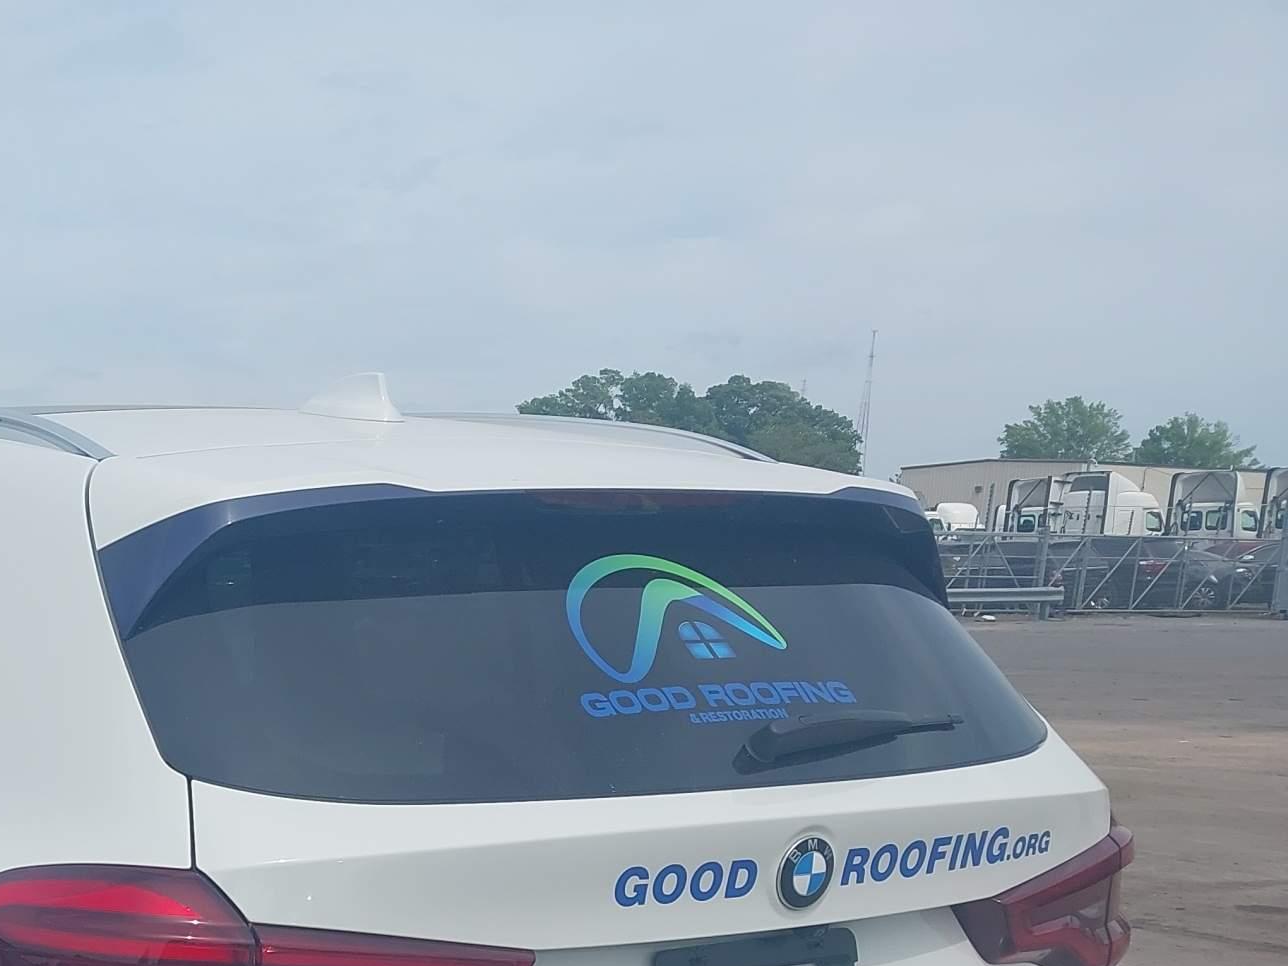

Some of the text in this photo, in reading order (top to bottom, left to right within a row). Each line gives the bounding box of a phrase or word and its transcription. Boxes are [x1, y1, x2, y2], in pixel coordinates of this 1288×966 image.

[580, 680, 857, 718] GOOD ROOFING
[788, 838, 832, 864] BMW
[614, 859, 758, 907] GOOD
